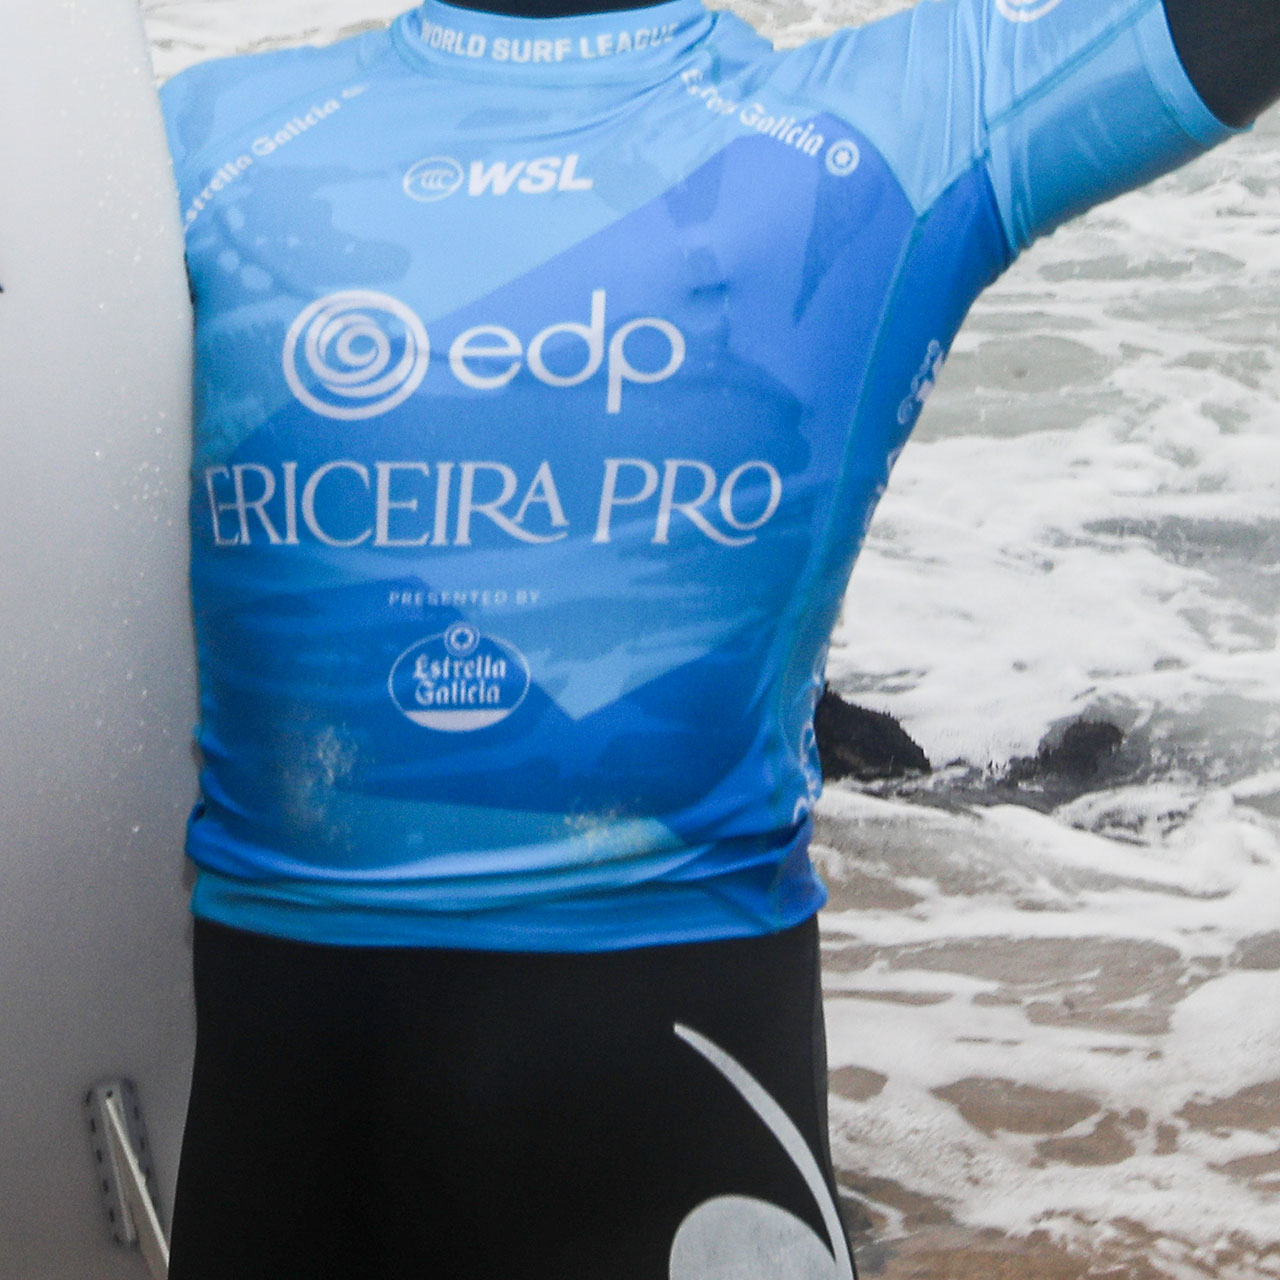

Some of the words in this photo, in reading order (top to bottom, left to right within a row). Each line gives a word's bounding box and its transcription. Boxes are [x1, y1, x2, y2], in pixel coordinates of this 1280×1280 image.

[421, 20, 487, 59] WORLD
[491, 37, 571, 63] SURF
[739, 102, 825, 158] Galicia
[183, 153, 254, 232] strella
[251, 97, 342, 157] Galicia
[467, 153, 594, 197] WSL
[448, 289, 686, 414] edp
[204, 460, 570, 548] ERICEIRA
[592, 458, 783, 548] PRO
[388, 589, 509, 607] PRESENTED
[515, 589, 540, 607] BY
[413, 652, 507, 680] Estrella
[414, 678, 501, 706] Galicia
